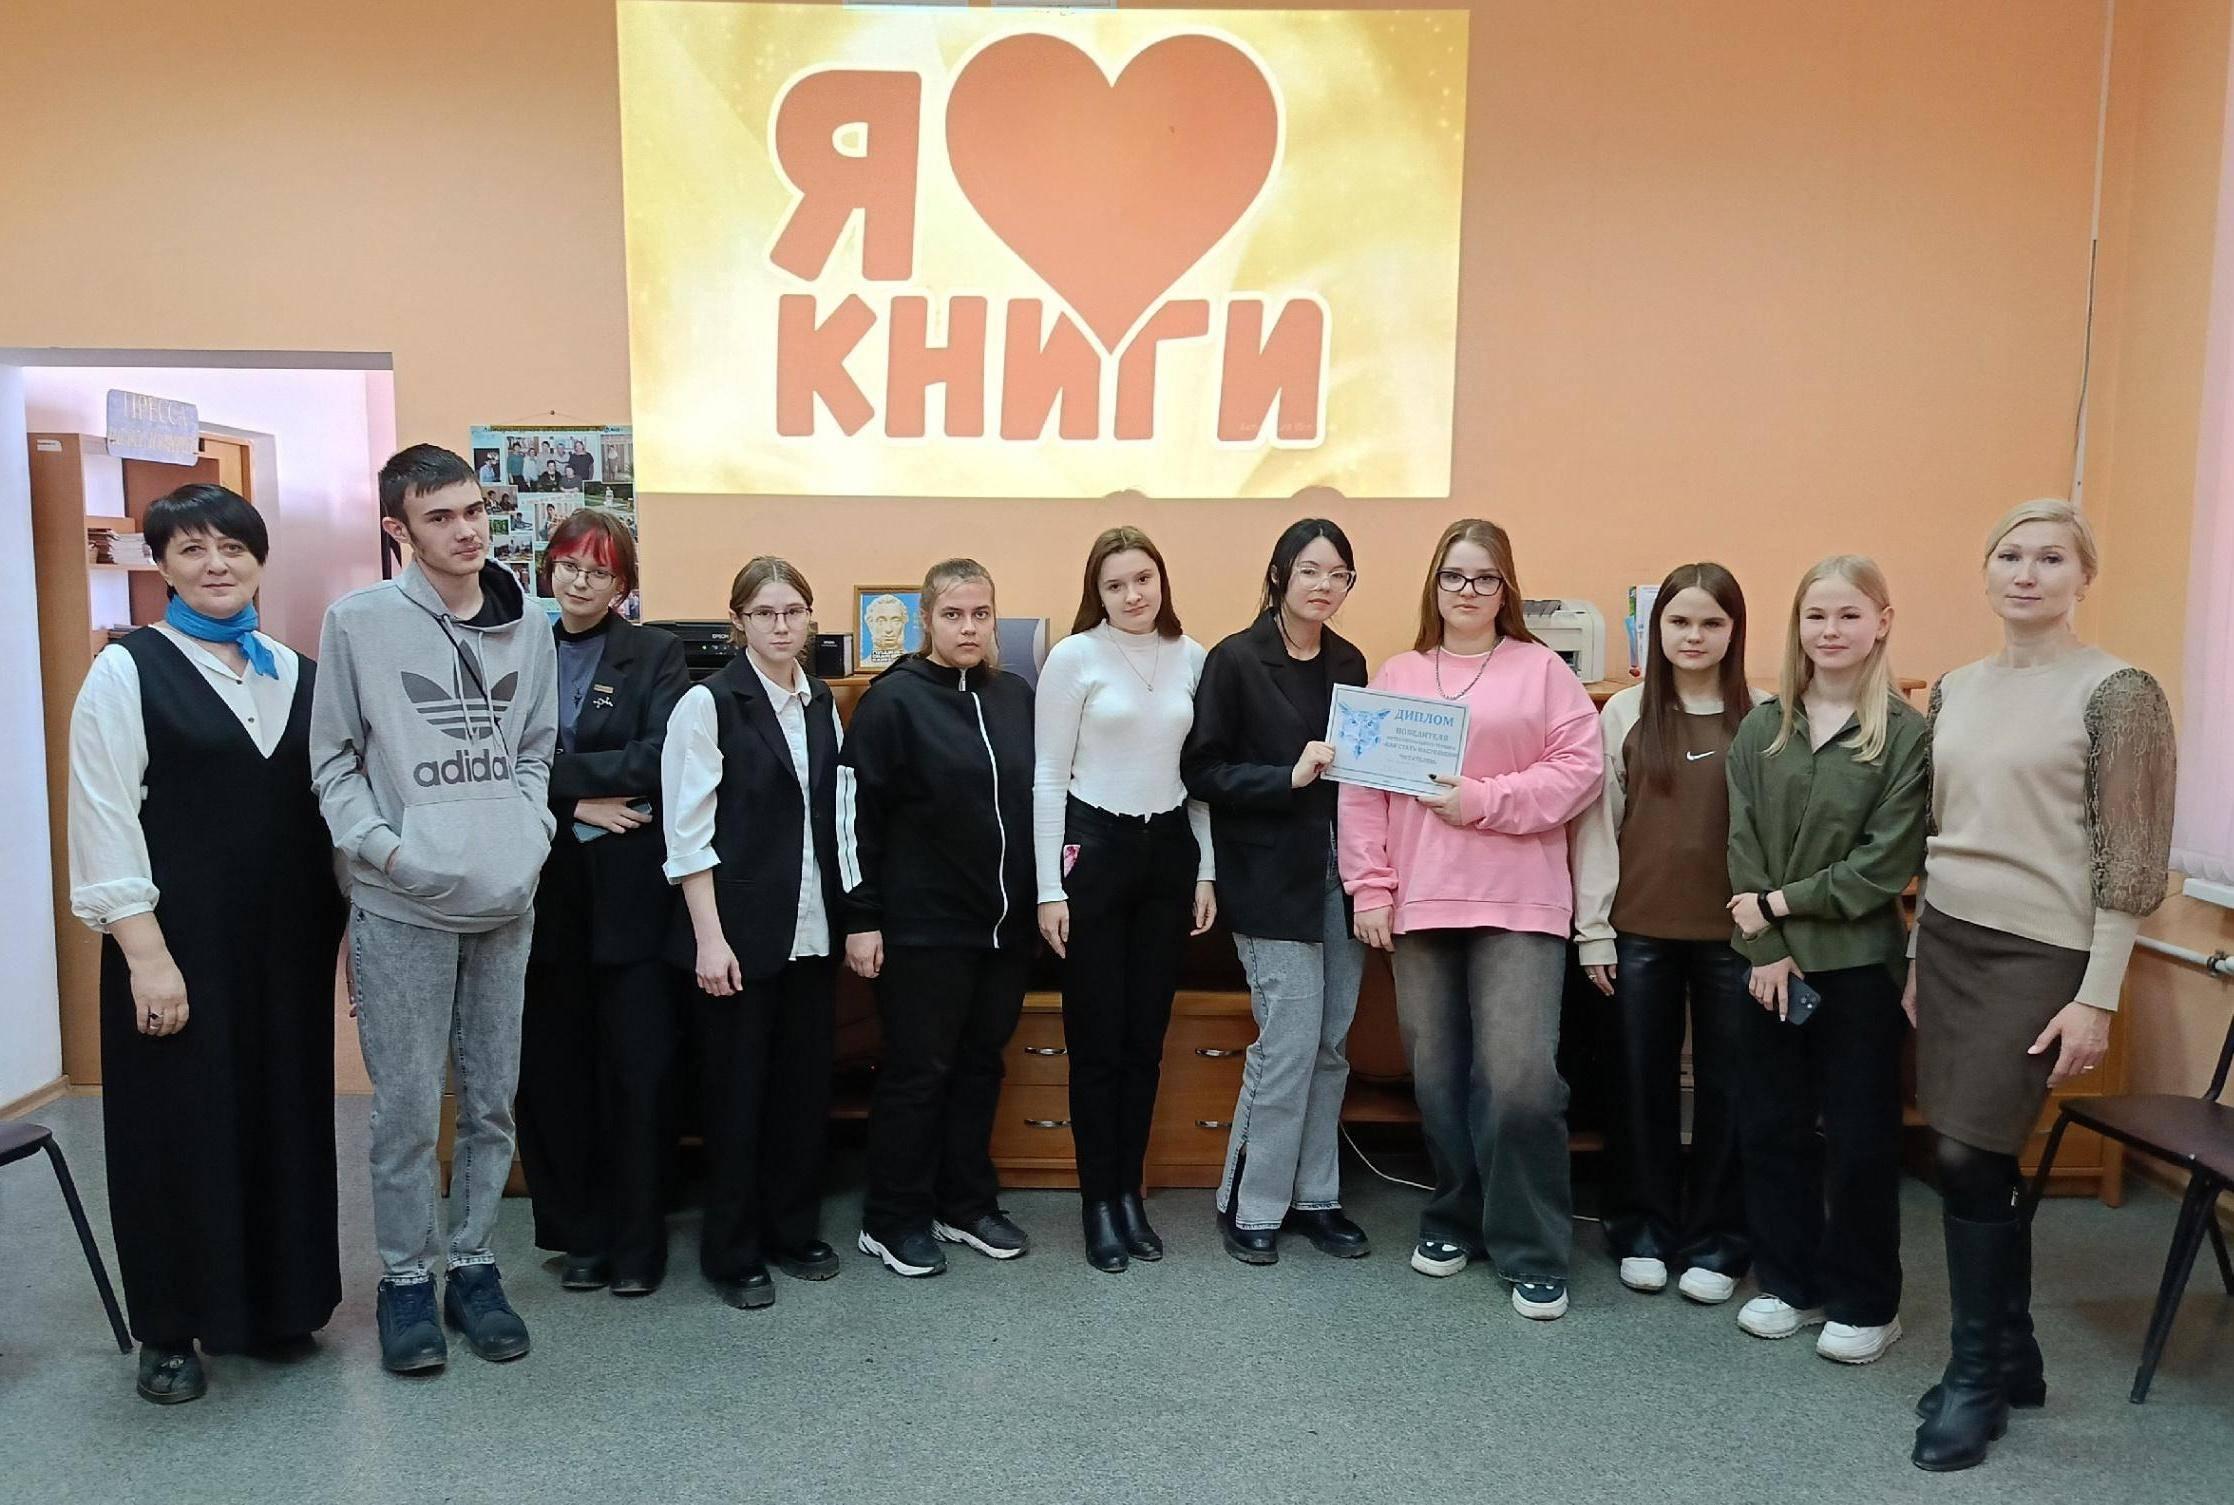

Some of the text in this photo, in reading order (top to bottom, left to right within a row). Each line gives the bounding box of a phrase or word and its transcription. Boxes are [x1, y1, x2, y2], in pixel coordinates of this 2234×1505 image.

[769, 69, 922, 282] Я
[776, 293, 1324, 441] КНИГИ
[1394, 708, 1454, 727] ДИПЛОМ
[413, 748, 511, 787] adida
